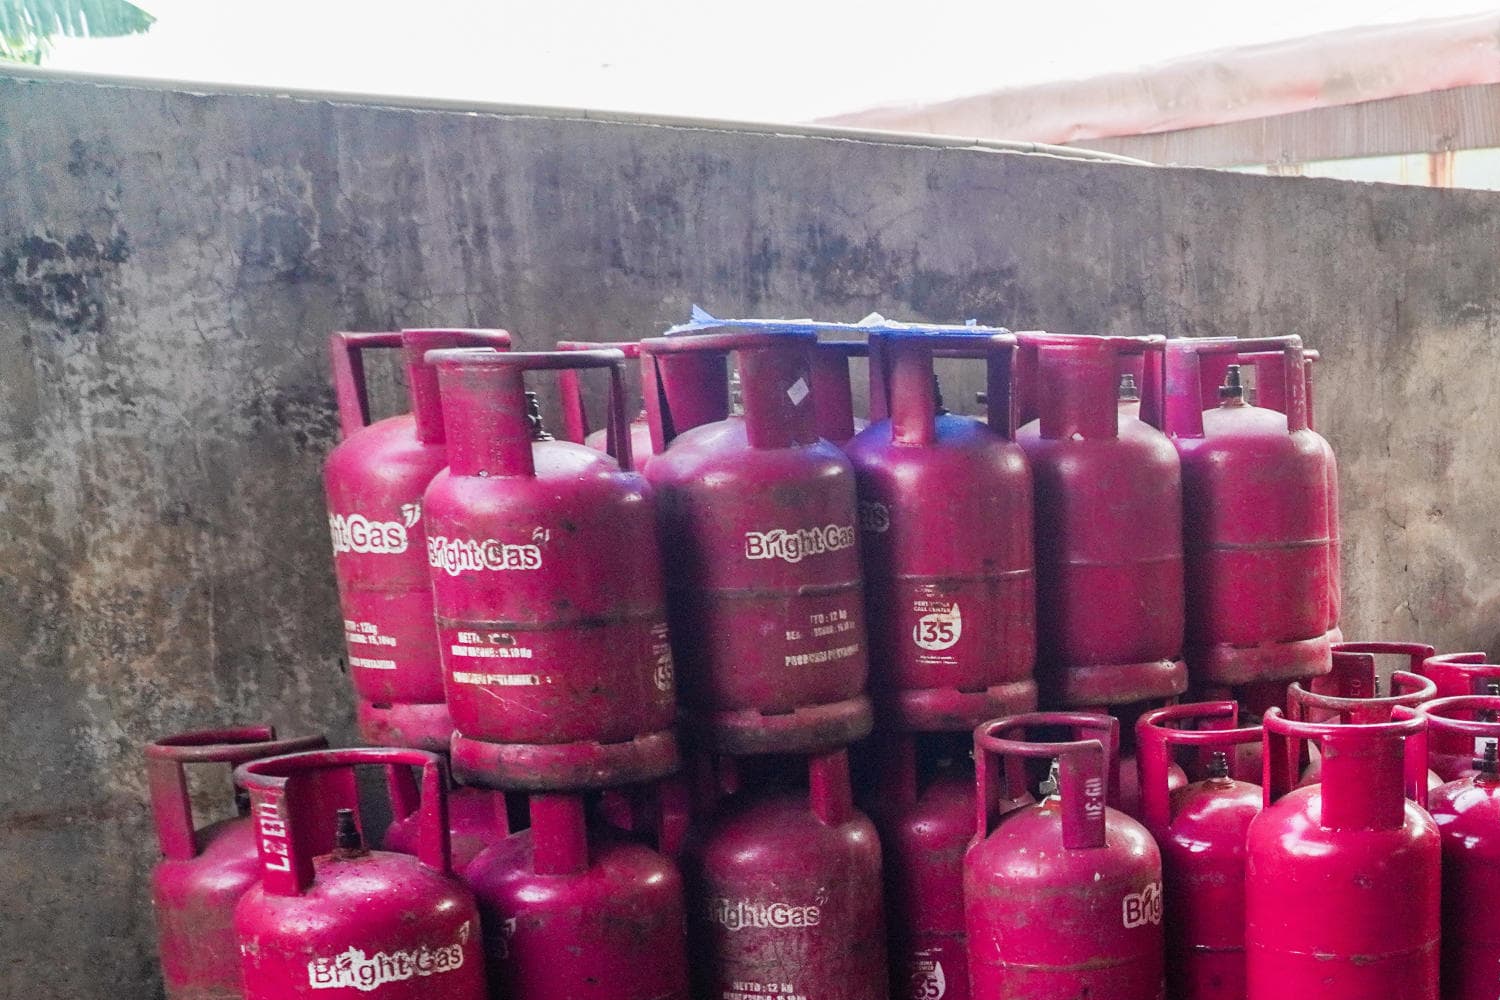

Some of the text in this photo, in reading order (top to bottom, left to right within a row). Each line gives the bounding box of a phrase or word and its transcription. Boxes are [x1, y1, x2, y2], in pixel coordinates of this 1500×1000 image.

[349, 513, 409, 554] Gas
[745, 523, 855, 563] Bright Gas
[481, 538, 543, 571] Gas
[916, 620, 955, 643] 135
[716, 897, 821, 932] ight Gas
[307, 943, 465, 992] Bright Gas
